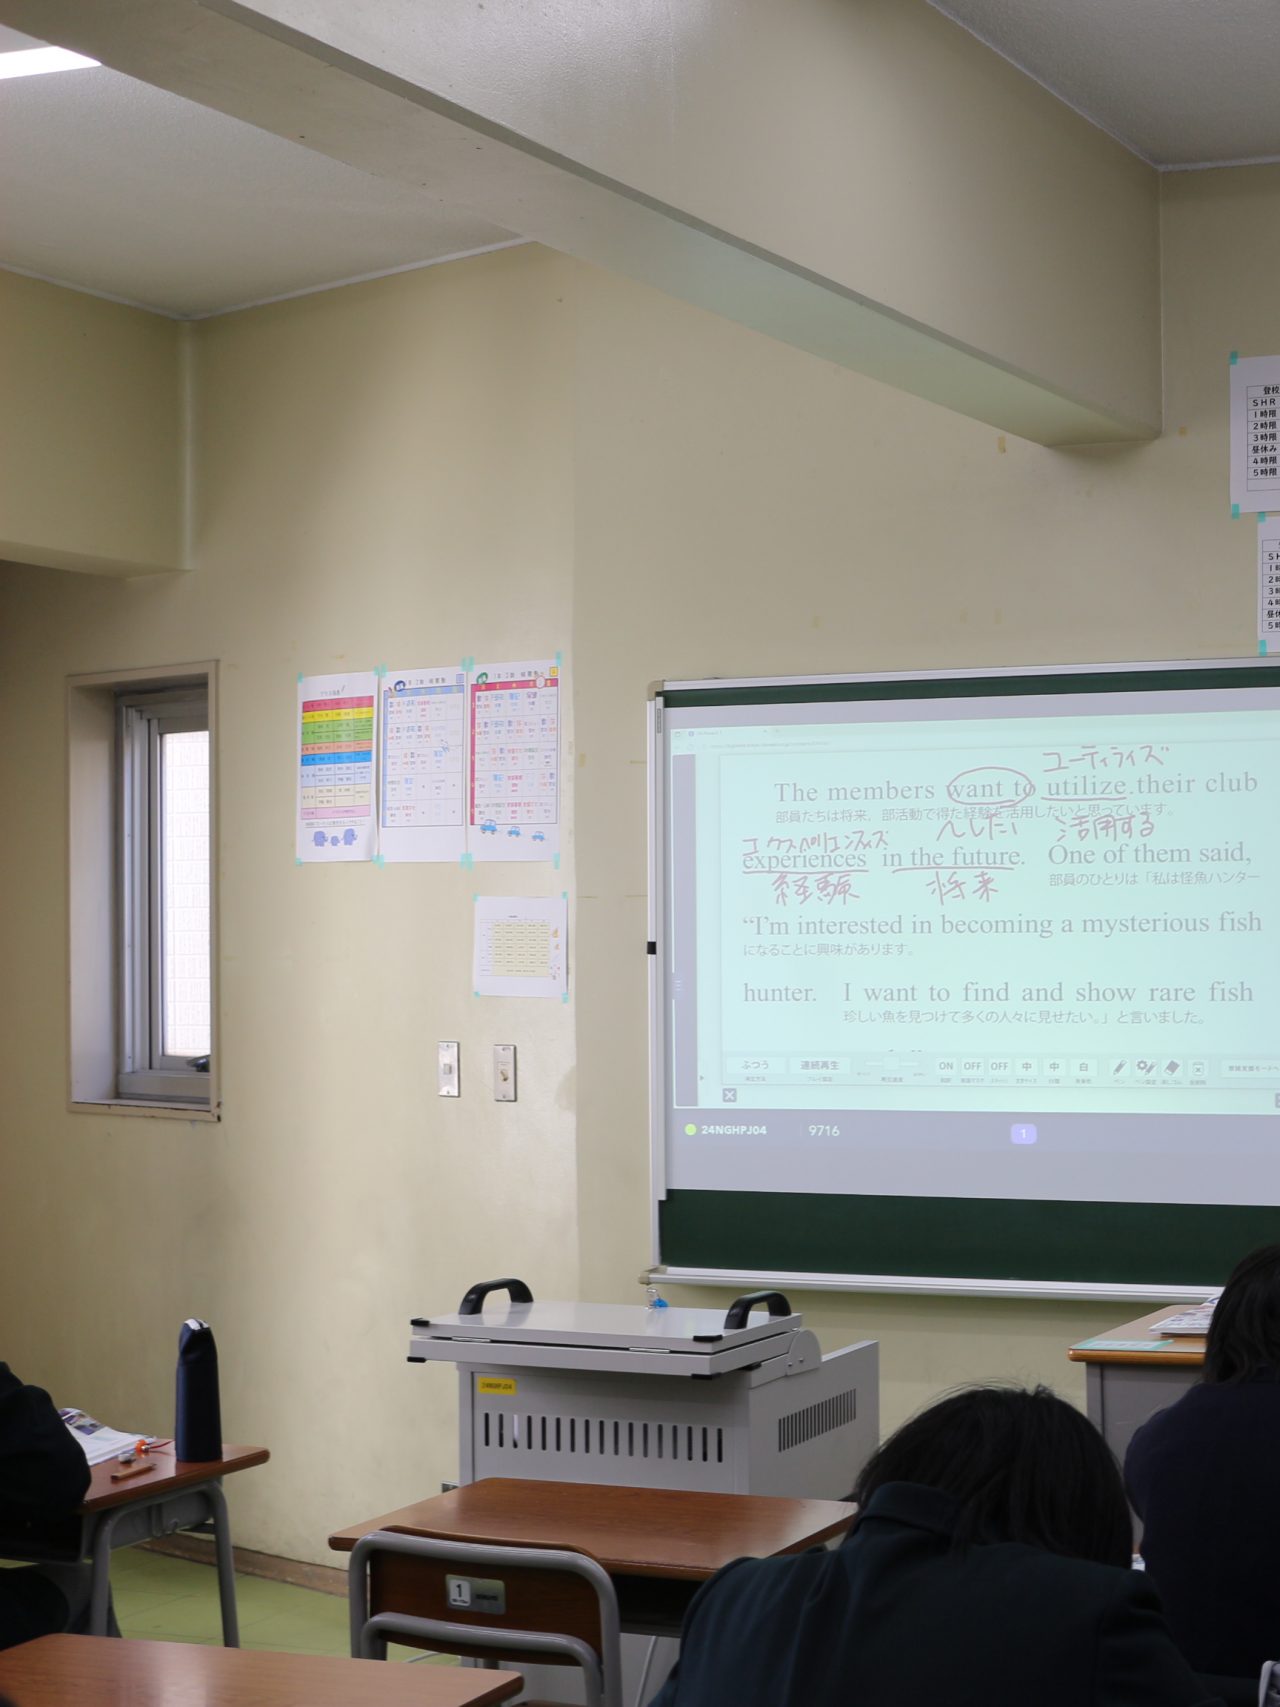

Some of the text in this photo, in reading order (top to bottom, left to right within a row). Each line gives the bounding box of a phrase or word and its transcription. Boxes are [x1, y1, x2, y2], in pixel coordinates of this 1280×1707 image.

[1252, 398, 1276, 407] SHR
[1254, 409, 1277, 418] 1時限
[1253, 421, 1277, 430] 2時限
[1253, 433, 1277, 442] 3時限
[1253, 456, 1277, 465] 4時限
[1253, 467, 1277, 477] 5時限
[774, 782, 818, 803] The
[828, 780, 936, 801] members
[945, 779, 1003, 799] want
[1014, 778, 1036, 798] to
[1136, 770, 1196, 794] their
[1205, 770, 1258, 793] club
[1055, 811, 1155, 842] 活用する
[742, 841, 1252, 873] experiences in the future. One of them said,
[771, 870, 999, 907] 経験 将来
[798, 914, 903, 935] interested
[911, 914, 933, 934] in
[941, 913, 1053, 939] becoming
[1061, 917, 1073, 933] a
[1082, 912, 1210, 938] mysterious
[1218, 910, 1262, 932] fish
[743, 980, 1254, 1002] hunter. I want to find and show rare fish
[741, 1060, 770, 1071] ふつう
[938, 1060, 954, 1071] ON
[963, 1060, 982, 1071] OFF
[990, 1060, 1009, 1071] OFF
[1022, 1061, 1033, 1072] 中
[1049, 1061, 1060, 1072] 中
[701, 1125, 768, 1136] 24NGHPJ04
[808, 1124, 841, 1137] 9716
[456, 1583, 463, 1599] 1
